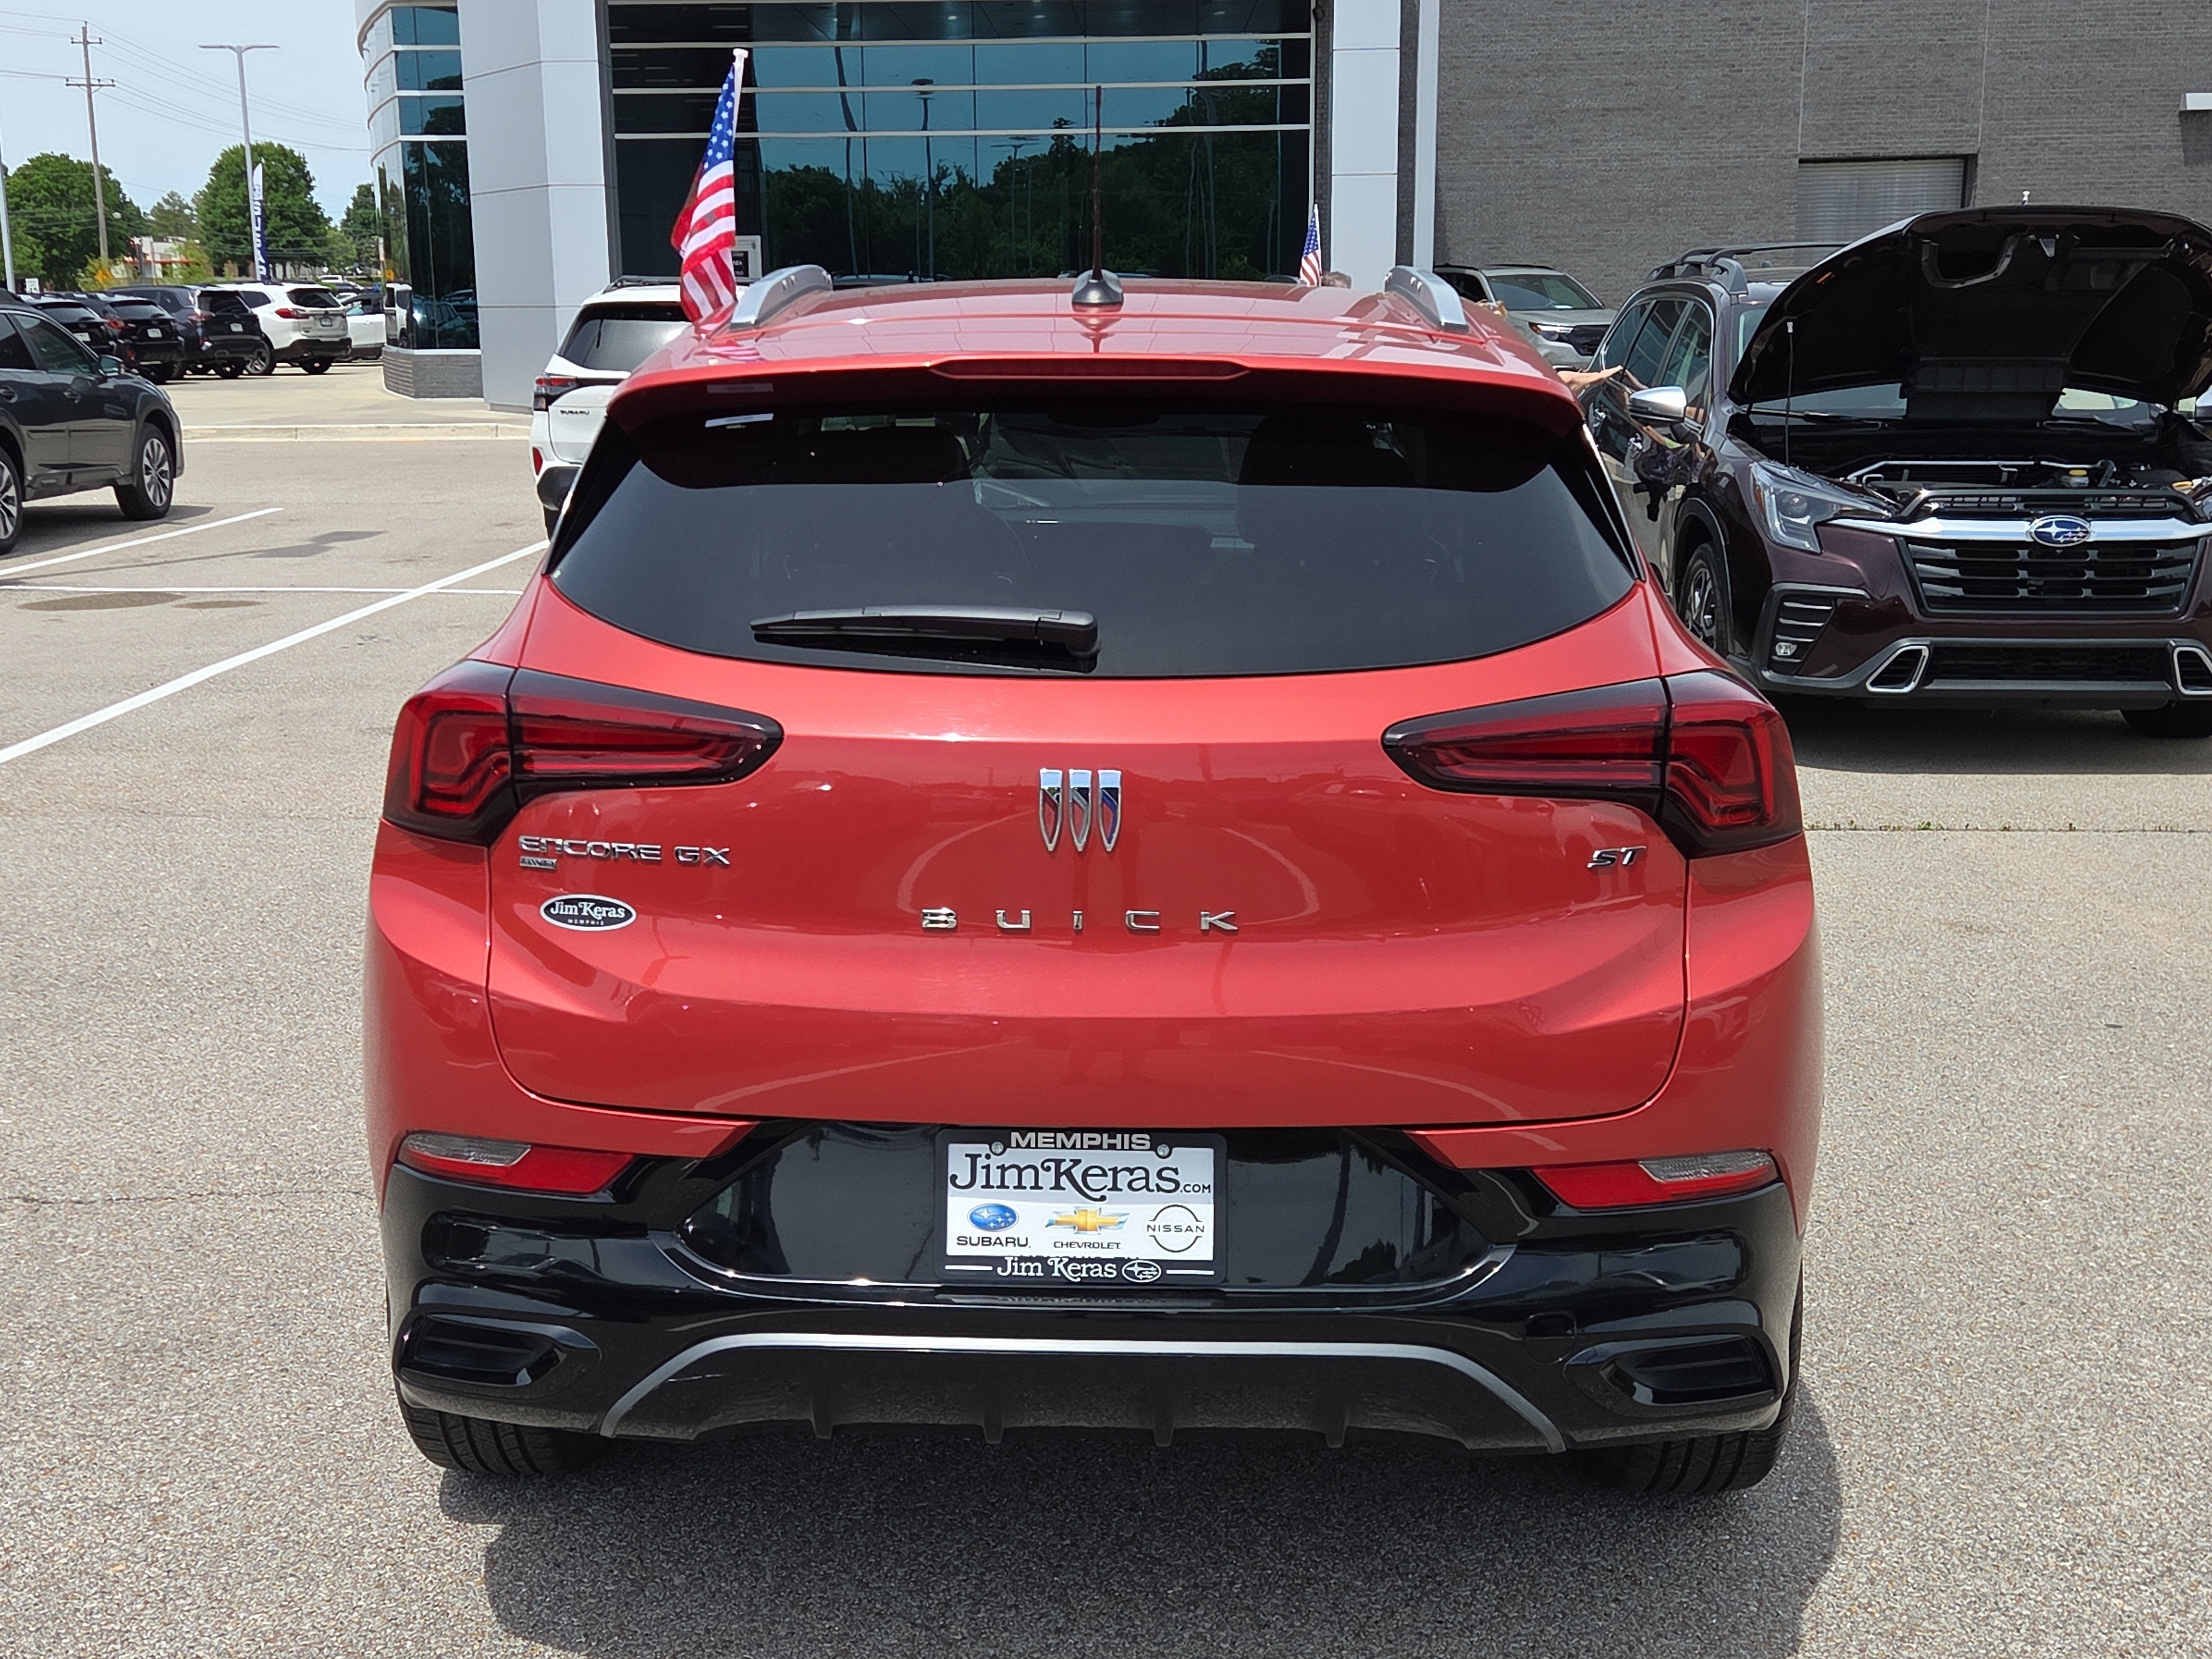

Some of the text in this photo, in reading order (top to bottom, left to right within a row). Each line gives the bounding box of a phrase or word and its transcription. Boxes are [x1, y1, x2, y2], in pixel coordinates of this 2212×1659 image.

[518, 835, 730, 865] ENCORE GX
[1587, 845, 1647, 869] ST
[921, 907, 1238, 930] BUICK
[1011, 1131, 1150, 1150] MEMPHIS
[1147, 1224, 1204, 1233] NISSAN
[956, 1236, 1029, 1248] SUBARU
[1053, 1241, 1121, 1249] CHEVROLET
[996, 1257, 1117, 1282] Jim Keras
